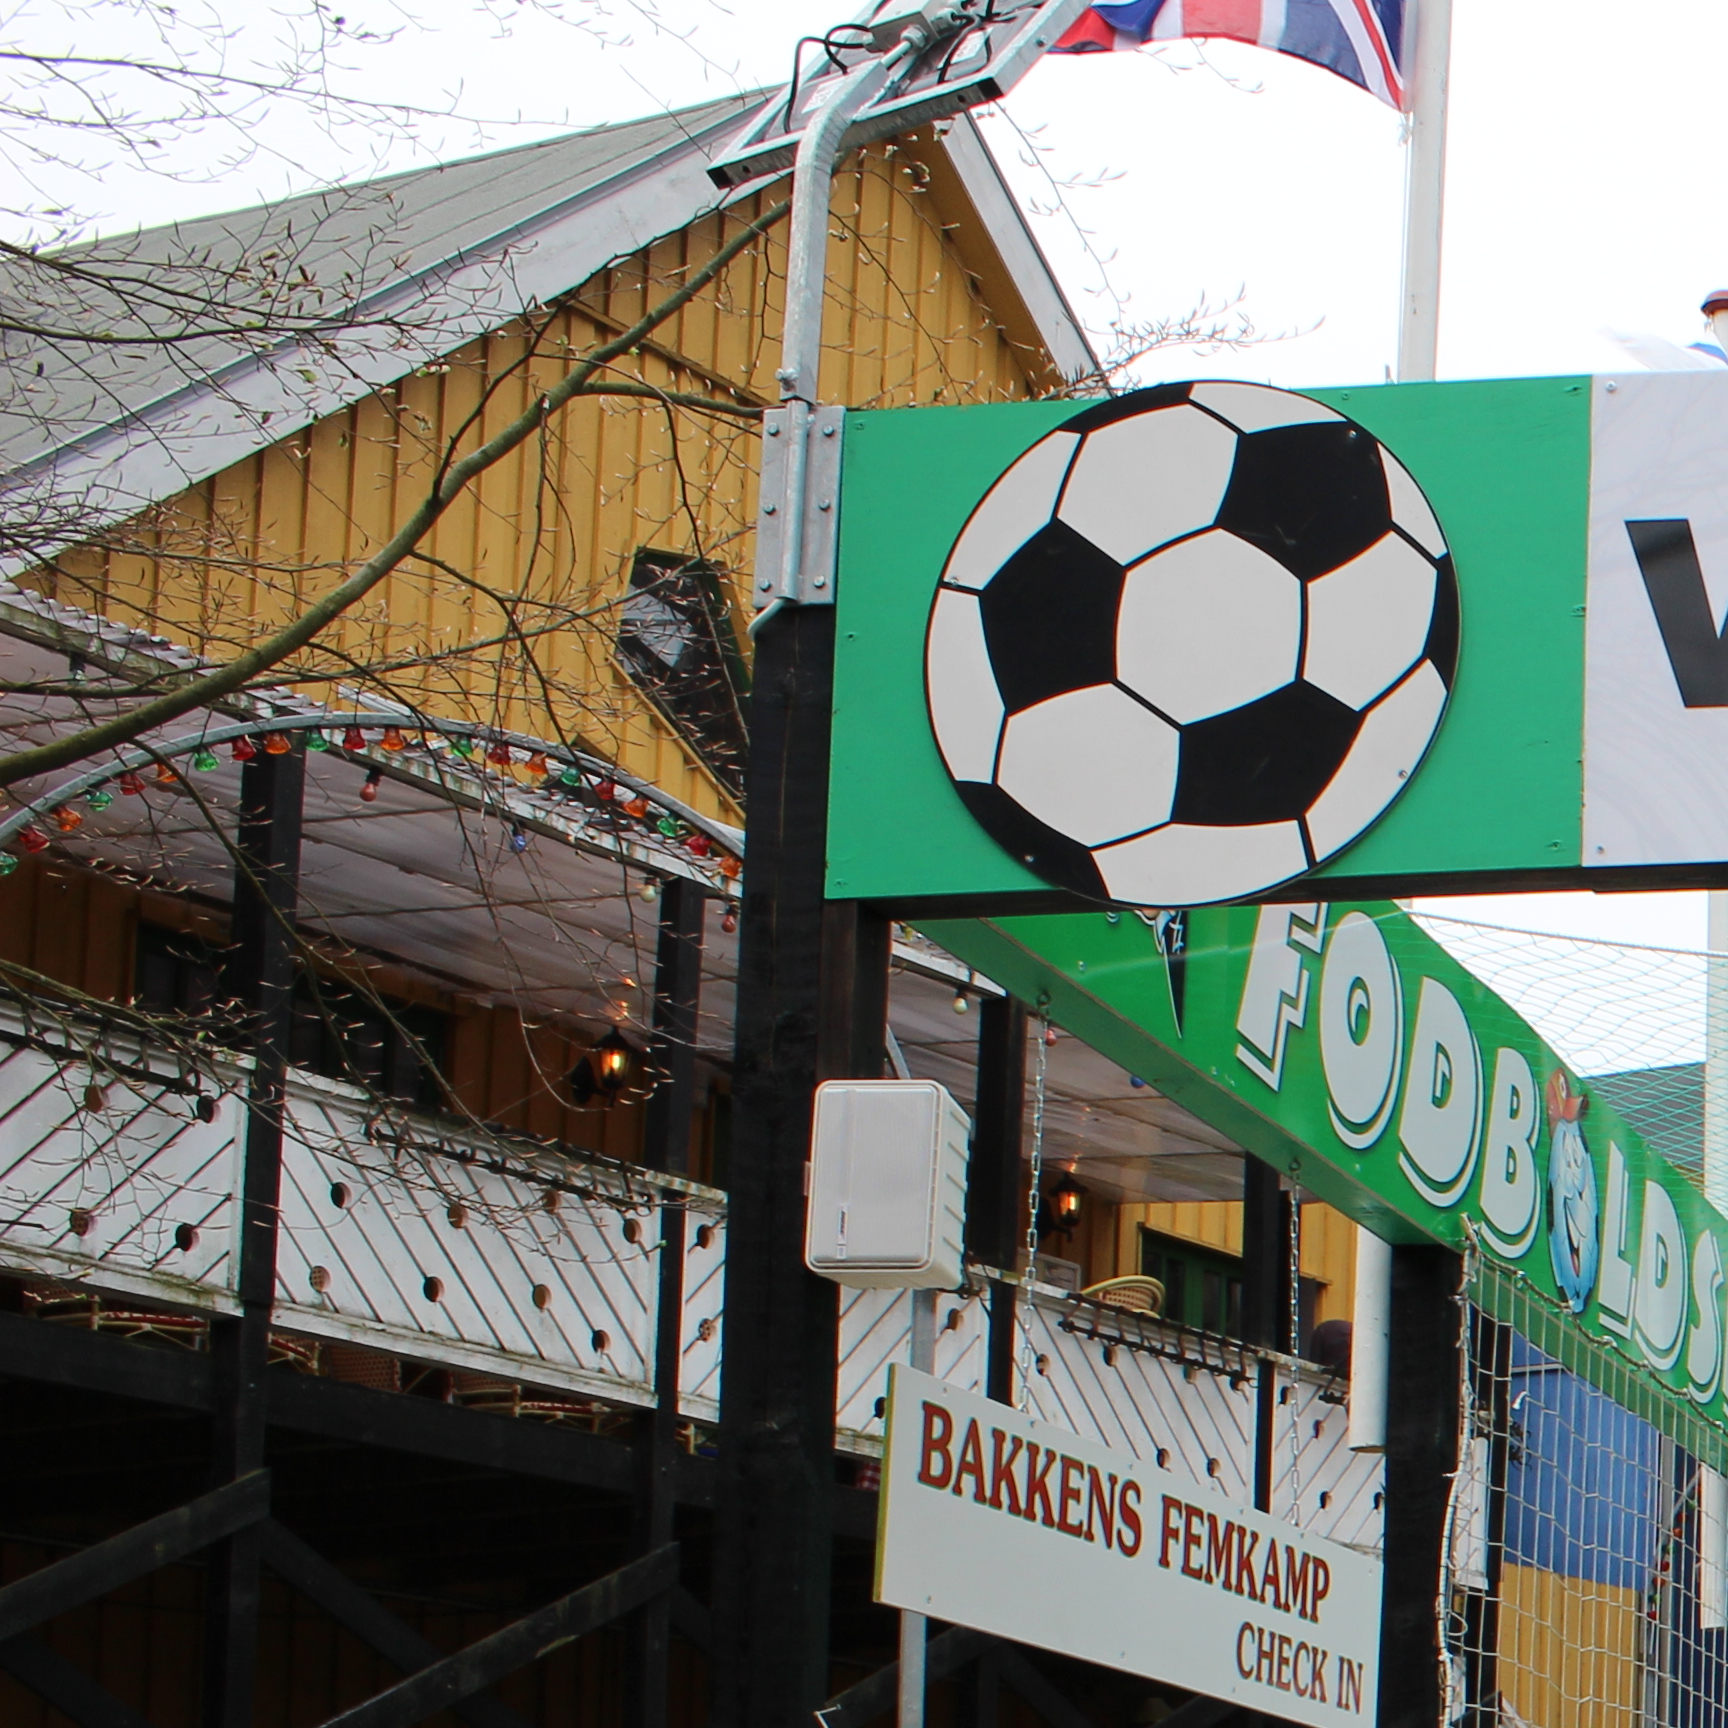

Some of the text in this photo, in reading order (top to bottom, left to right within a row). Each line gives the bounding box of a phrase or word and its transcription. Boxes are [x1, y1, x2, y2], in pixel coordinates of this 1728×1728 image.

[918, 1400, 1331, 1624] BAKKENS FEMKAMP
[1237, 1621, 1364, 1715] CHECK IN
